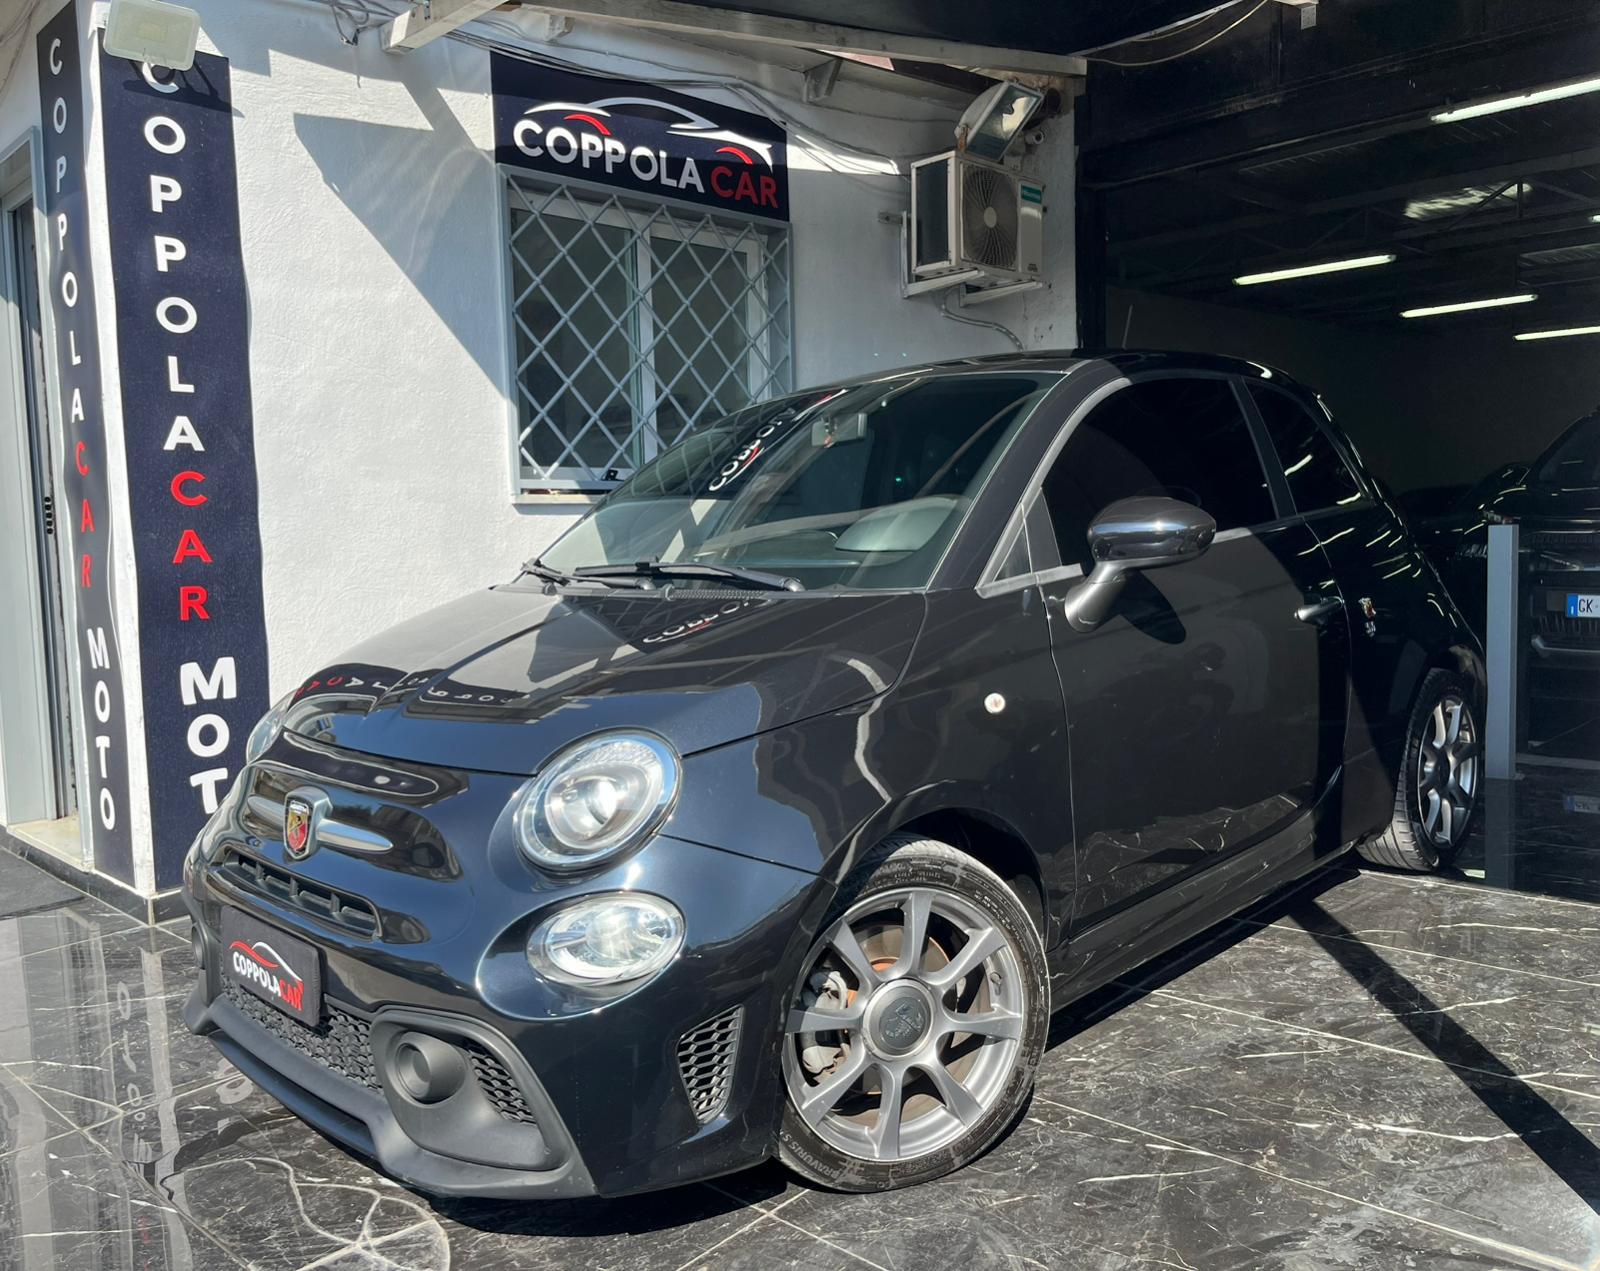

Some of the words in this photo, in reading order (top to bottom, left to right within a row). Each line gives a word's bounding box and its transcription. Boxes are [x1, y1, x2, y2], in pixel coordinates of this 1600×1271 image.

[513, 119, 705, 193] COPPOLA
[710, 166, 778, 209] CAR
[49, 38, 85, 424] COPPOLA
[75, 441, 94, 588] CAR
[87, 627, 115, 830] MOTO
[170, 471, 213, 621] CAR
[180, 657, 237, 815] MOT
[233, 951, 281, 997] COPPOLA
